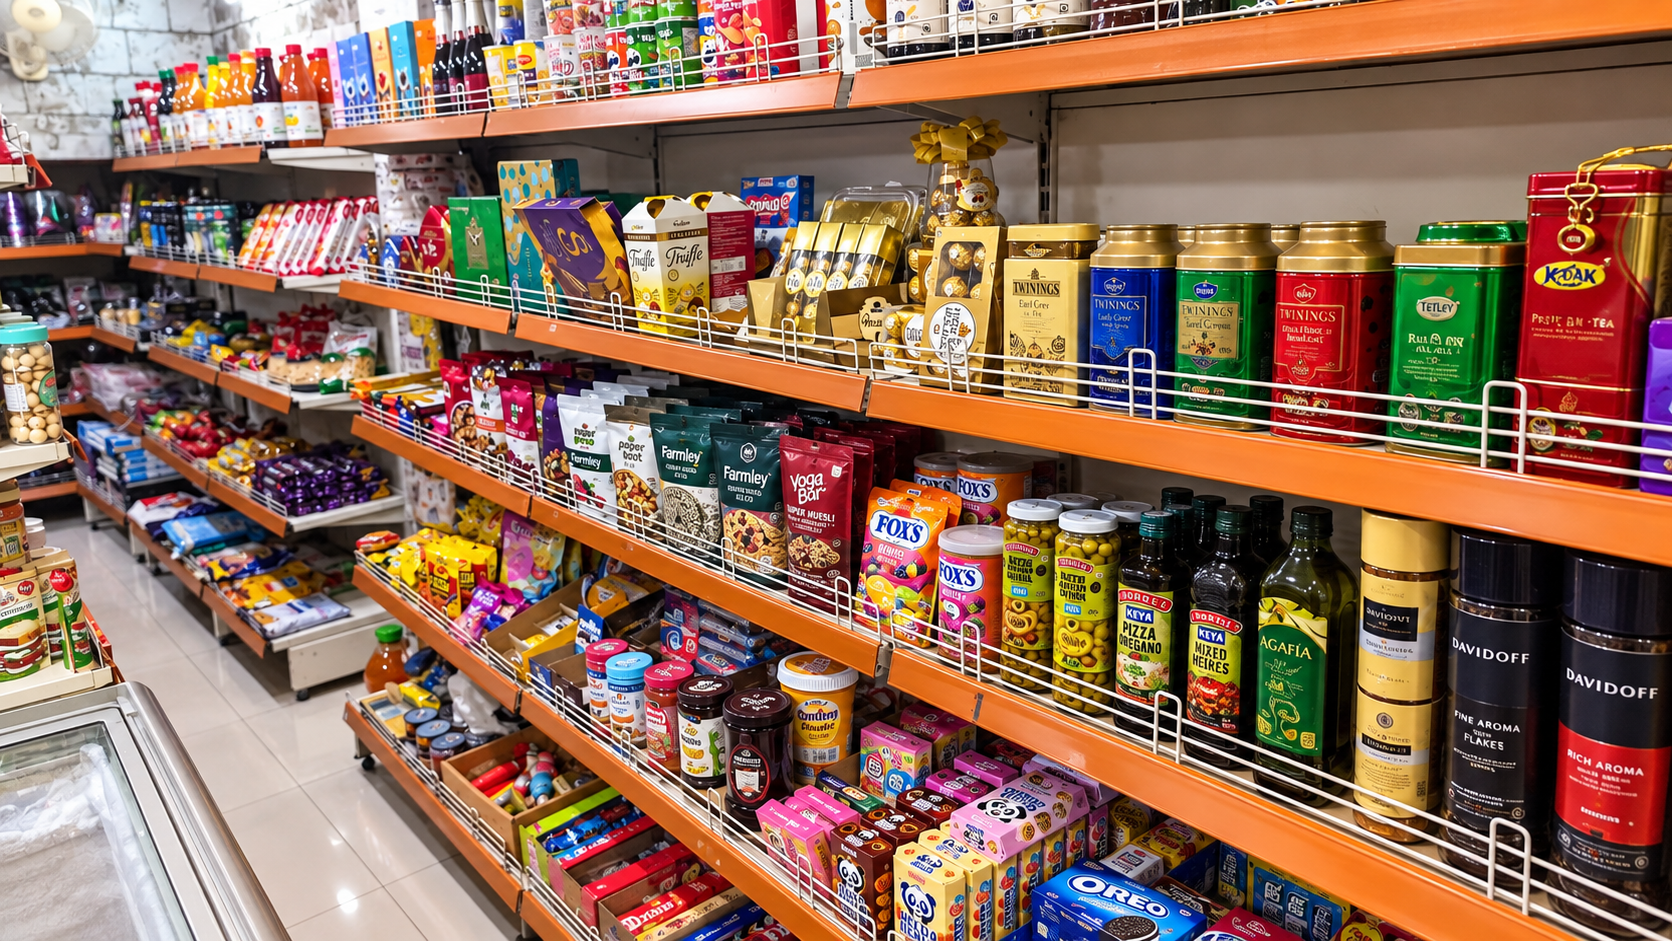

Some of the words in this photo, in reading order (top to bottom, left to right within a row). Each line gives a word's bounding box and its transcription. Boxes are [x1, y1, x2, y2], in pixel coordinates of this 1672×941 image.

[1013, 281, 1060, 296] TWININGS
[1420, 301, 1454, 313] TETLEY
[723, 465, 769, 489] Farmley
[789, 472, 824, 492] Yoga
[797, 486, 827, 505] Bar
[875, 514, 924, 543] FOX'S
[1122, 620, 1156, 642] PIZZA
[1452, 636, 1531, 665] DAVIDOFF
[1566, 667, 1659, 700] DAVIDOFF
[1454, 709, 1475, 725] FINE
[1476, 719, 1521, 733] AROMA
[1463, 732, 1505, 751] FLAKES
[1566, 748, 1592, 767] RICH
[1595, 761, 1645, 777] AROMA
[1071, 875, 1168, 918] OREO
